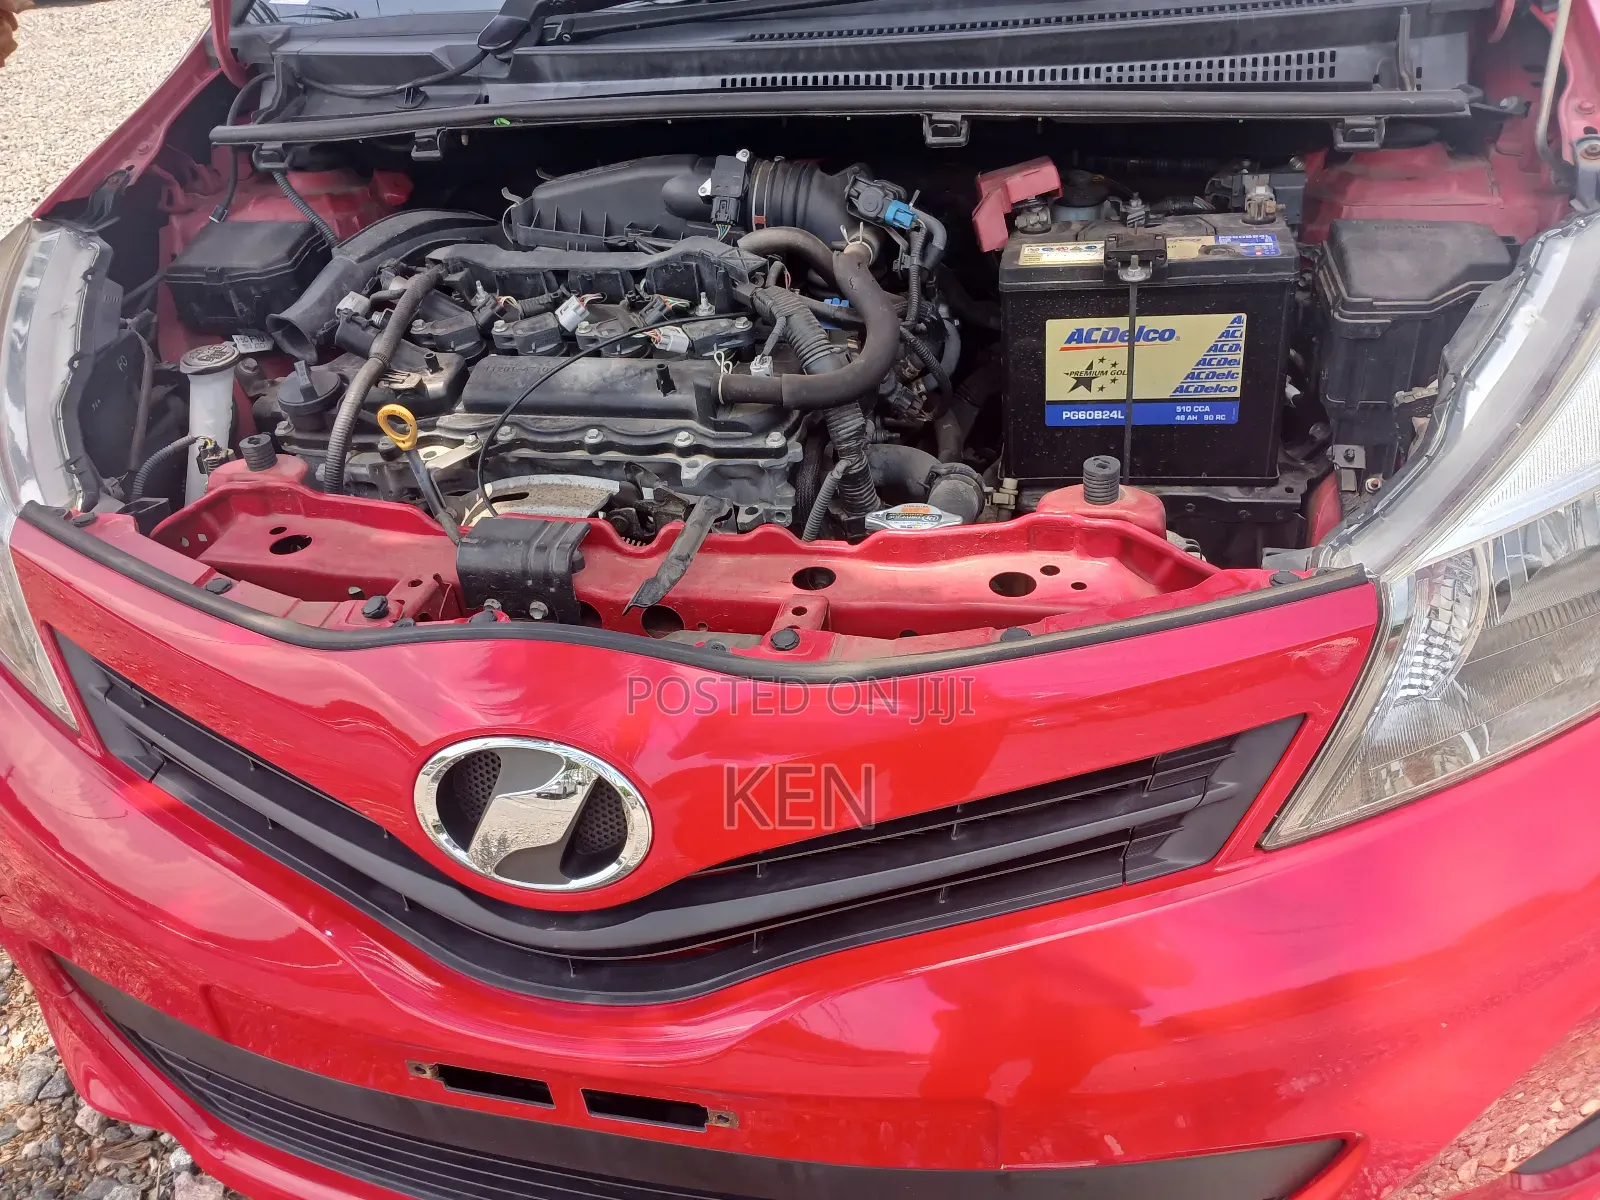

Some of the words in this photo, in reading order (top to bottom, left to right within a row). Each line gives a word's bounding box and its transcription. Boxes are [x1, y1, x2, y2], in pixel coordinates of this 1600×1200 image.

[1229, 315, 1243, 325] A
[1064, 325, 1176, 344] ACDelco
[1217, 329, 1243, 339] AC
[1206, 343, 1242, 353] ACD
[1183, 370, 1239, 380] ACDelc
[1172, 383, 1238, 394] ACDelco
[1176, 405, 1192, 413] 510
[1062, 410, 1125, 420] PG60B24L
